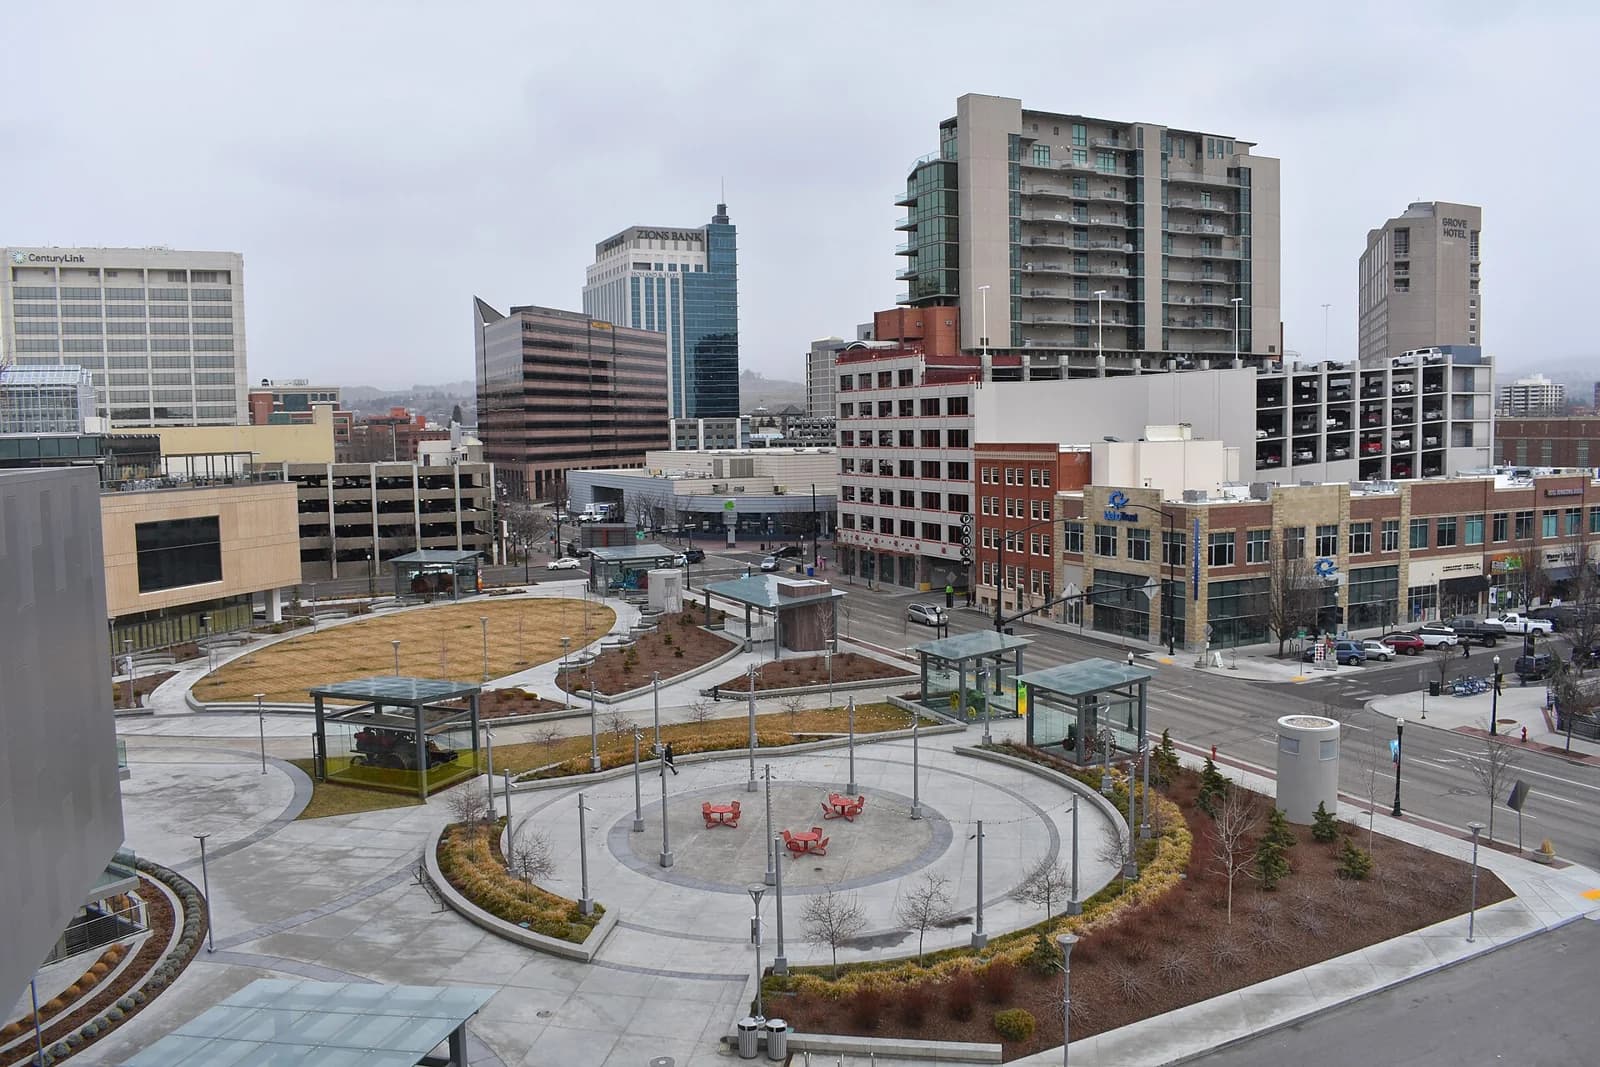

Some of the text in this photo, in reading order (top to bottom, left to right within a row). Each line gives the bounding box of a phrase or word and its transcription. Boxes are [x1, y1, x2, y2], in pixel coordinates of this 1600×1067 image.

[1442, 217, 1467, 228] GROVE
[637, 230, 703, 242] ZIONS BANK
[1443, 228, 1466, 239] HOTEL
[28, 253, 85, 263] CenturyLink
